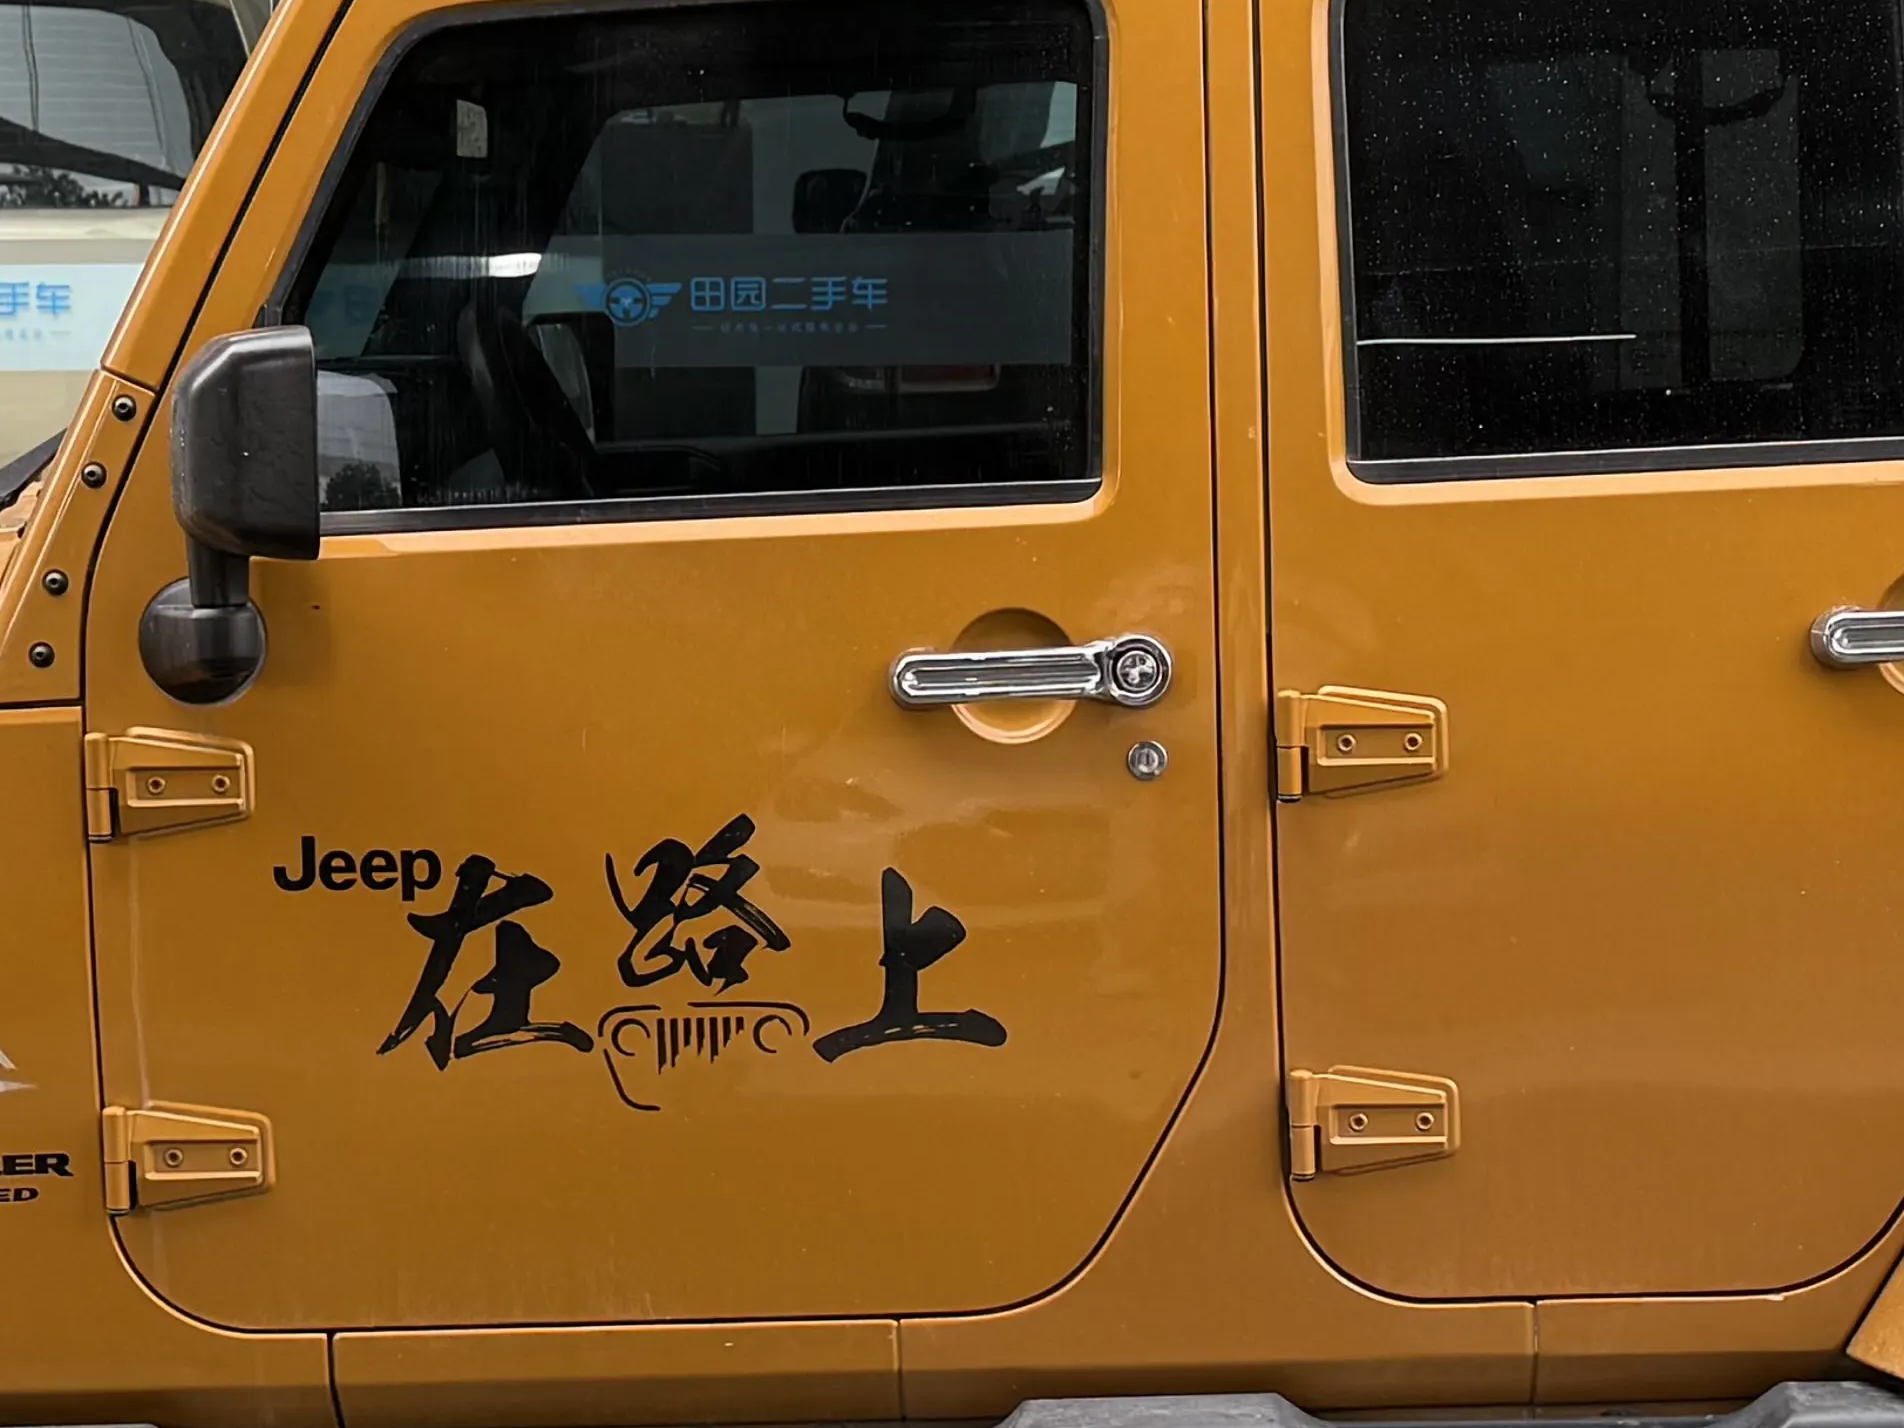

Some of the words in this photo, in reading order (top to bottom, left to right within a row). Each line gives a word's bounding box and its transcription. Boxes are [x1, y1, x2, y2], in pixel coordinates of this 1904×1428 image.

[690, 276, 889, 312] 田园二手车
[272, 835, 442, 903] Jeep
[375, 812, 1008, 1072] 在路上
